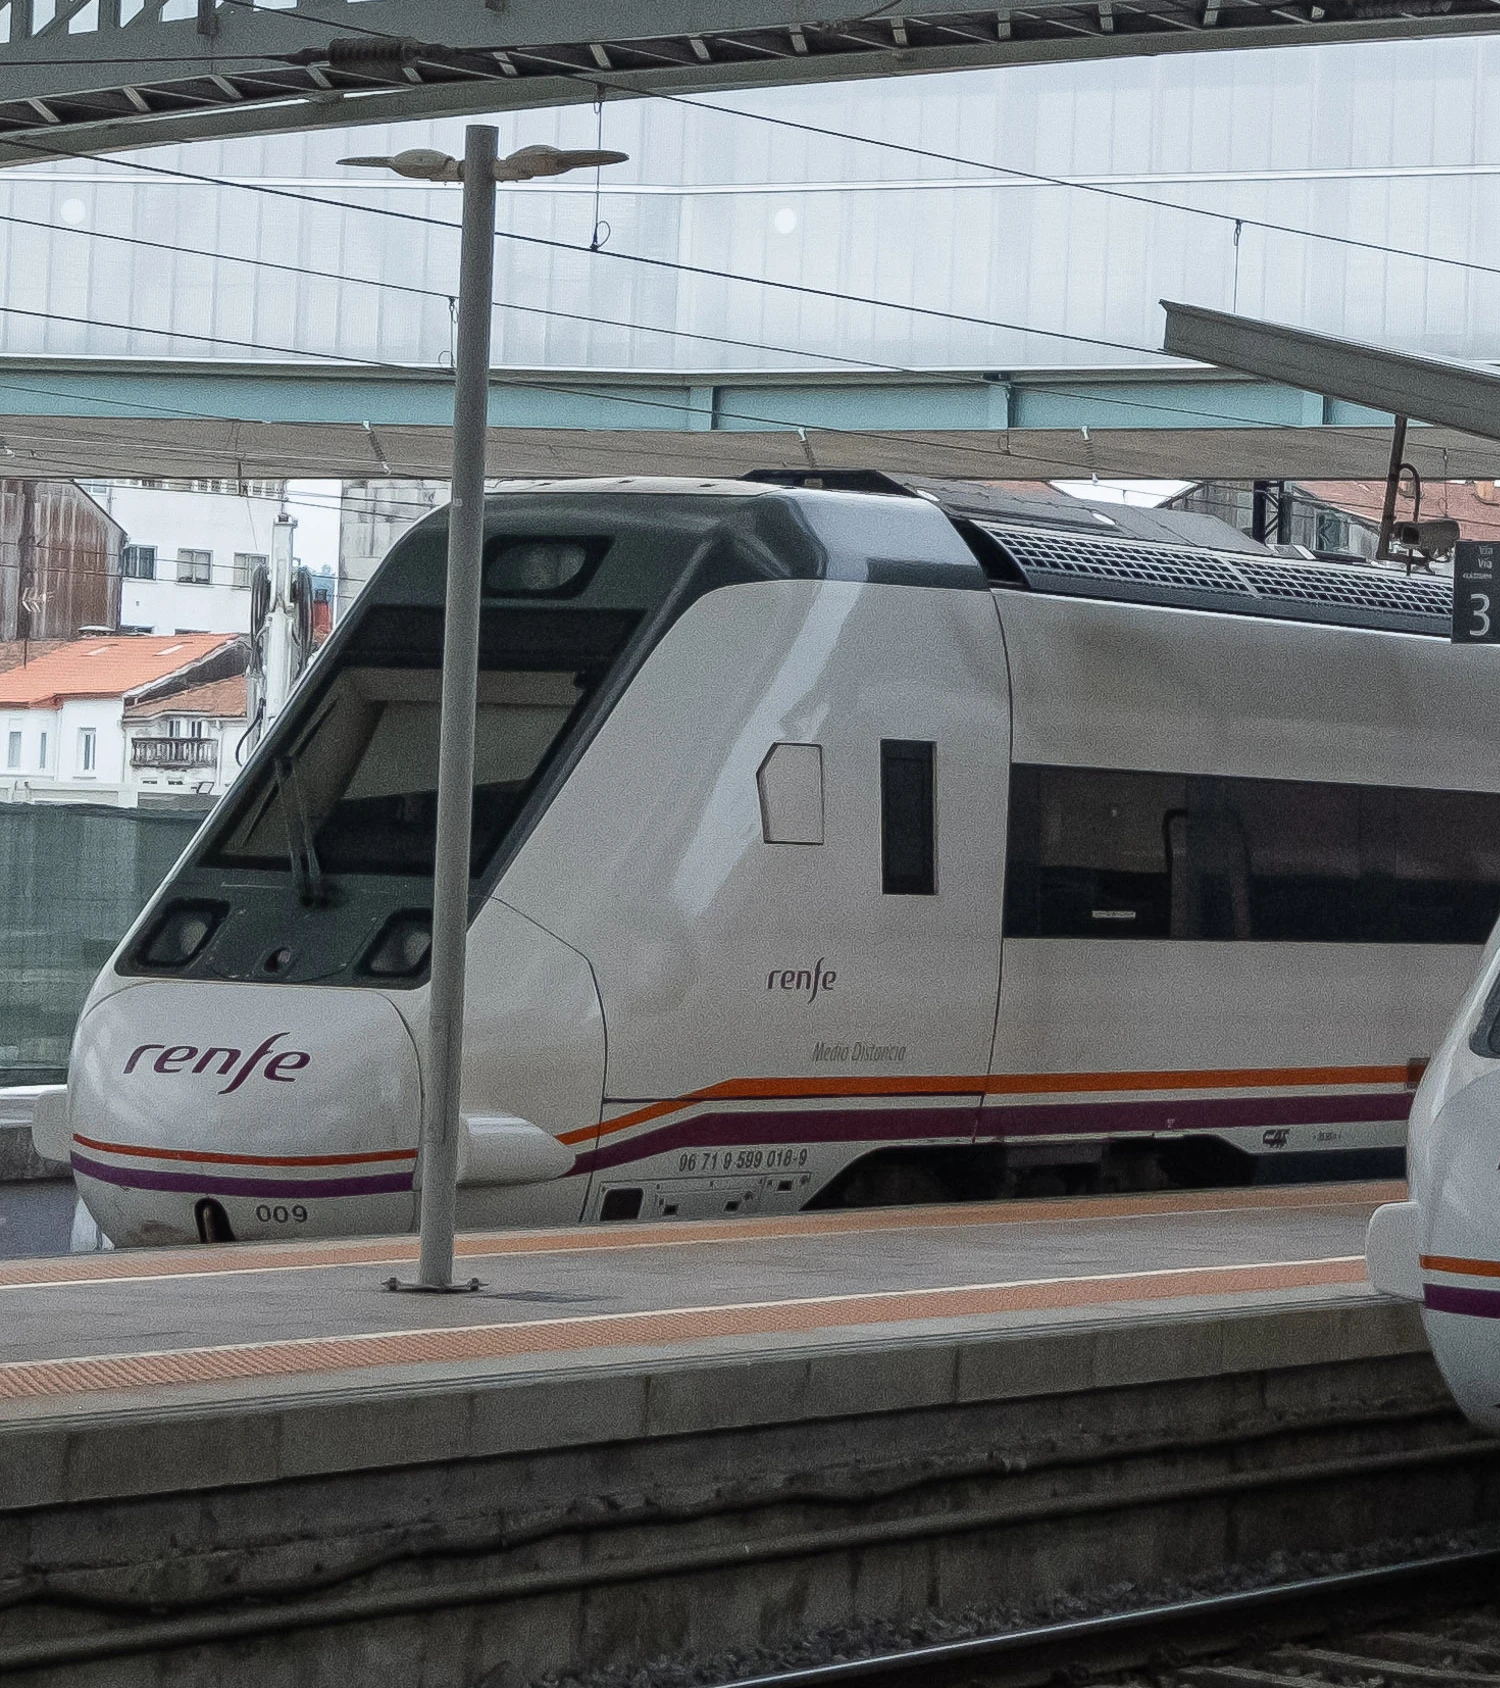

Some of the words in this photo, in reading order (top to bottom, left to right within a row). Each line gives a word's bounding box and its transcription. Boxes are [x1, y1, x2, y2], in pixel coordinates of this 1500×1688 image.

[1469, 593, 1490, 636] 3
[766, 956, 838, 1005] renfe
[123, 1031, 311, 1096] renfe
[701, 1152, 719, 1171] 71
[255, 1204, 309, 1223] 009
